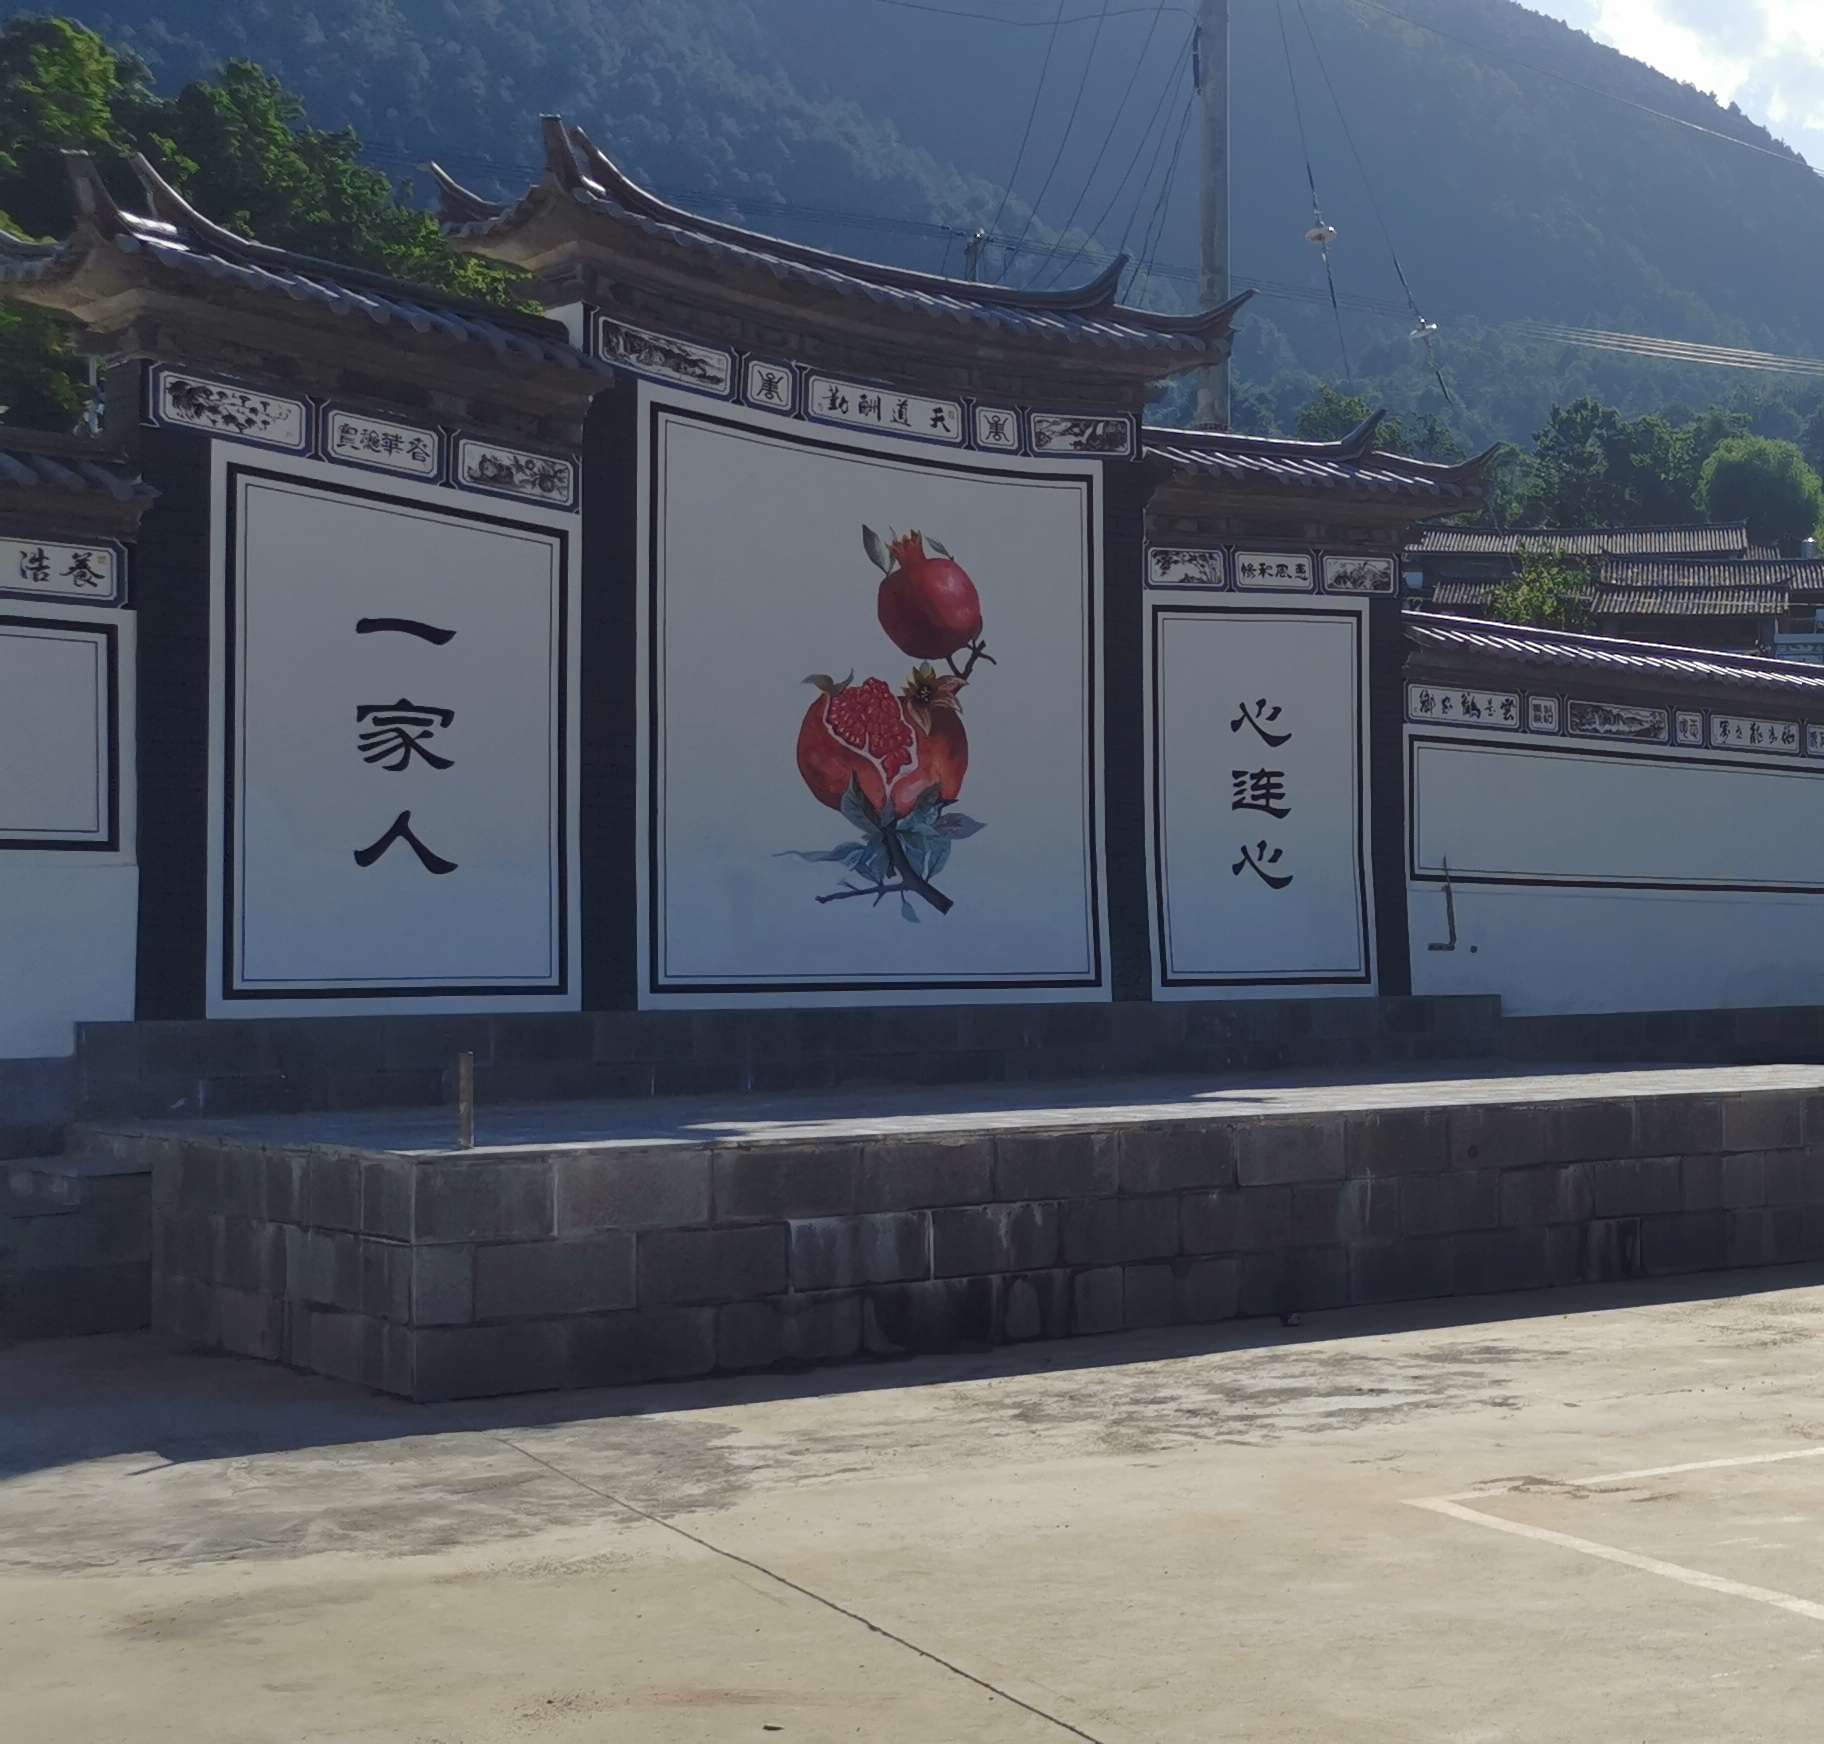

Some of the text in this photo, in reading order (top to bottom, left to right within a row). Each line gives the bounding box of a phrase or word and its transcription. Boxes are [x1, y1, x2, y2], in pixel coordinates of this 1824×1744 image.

[354, 617, 458, 875] 一家人
[1230, 698, 1293, 890] 心连心
